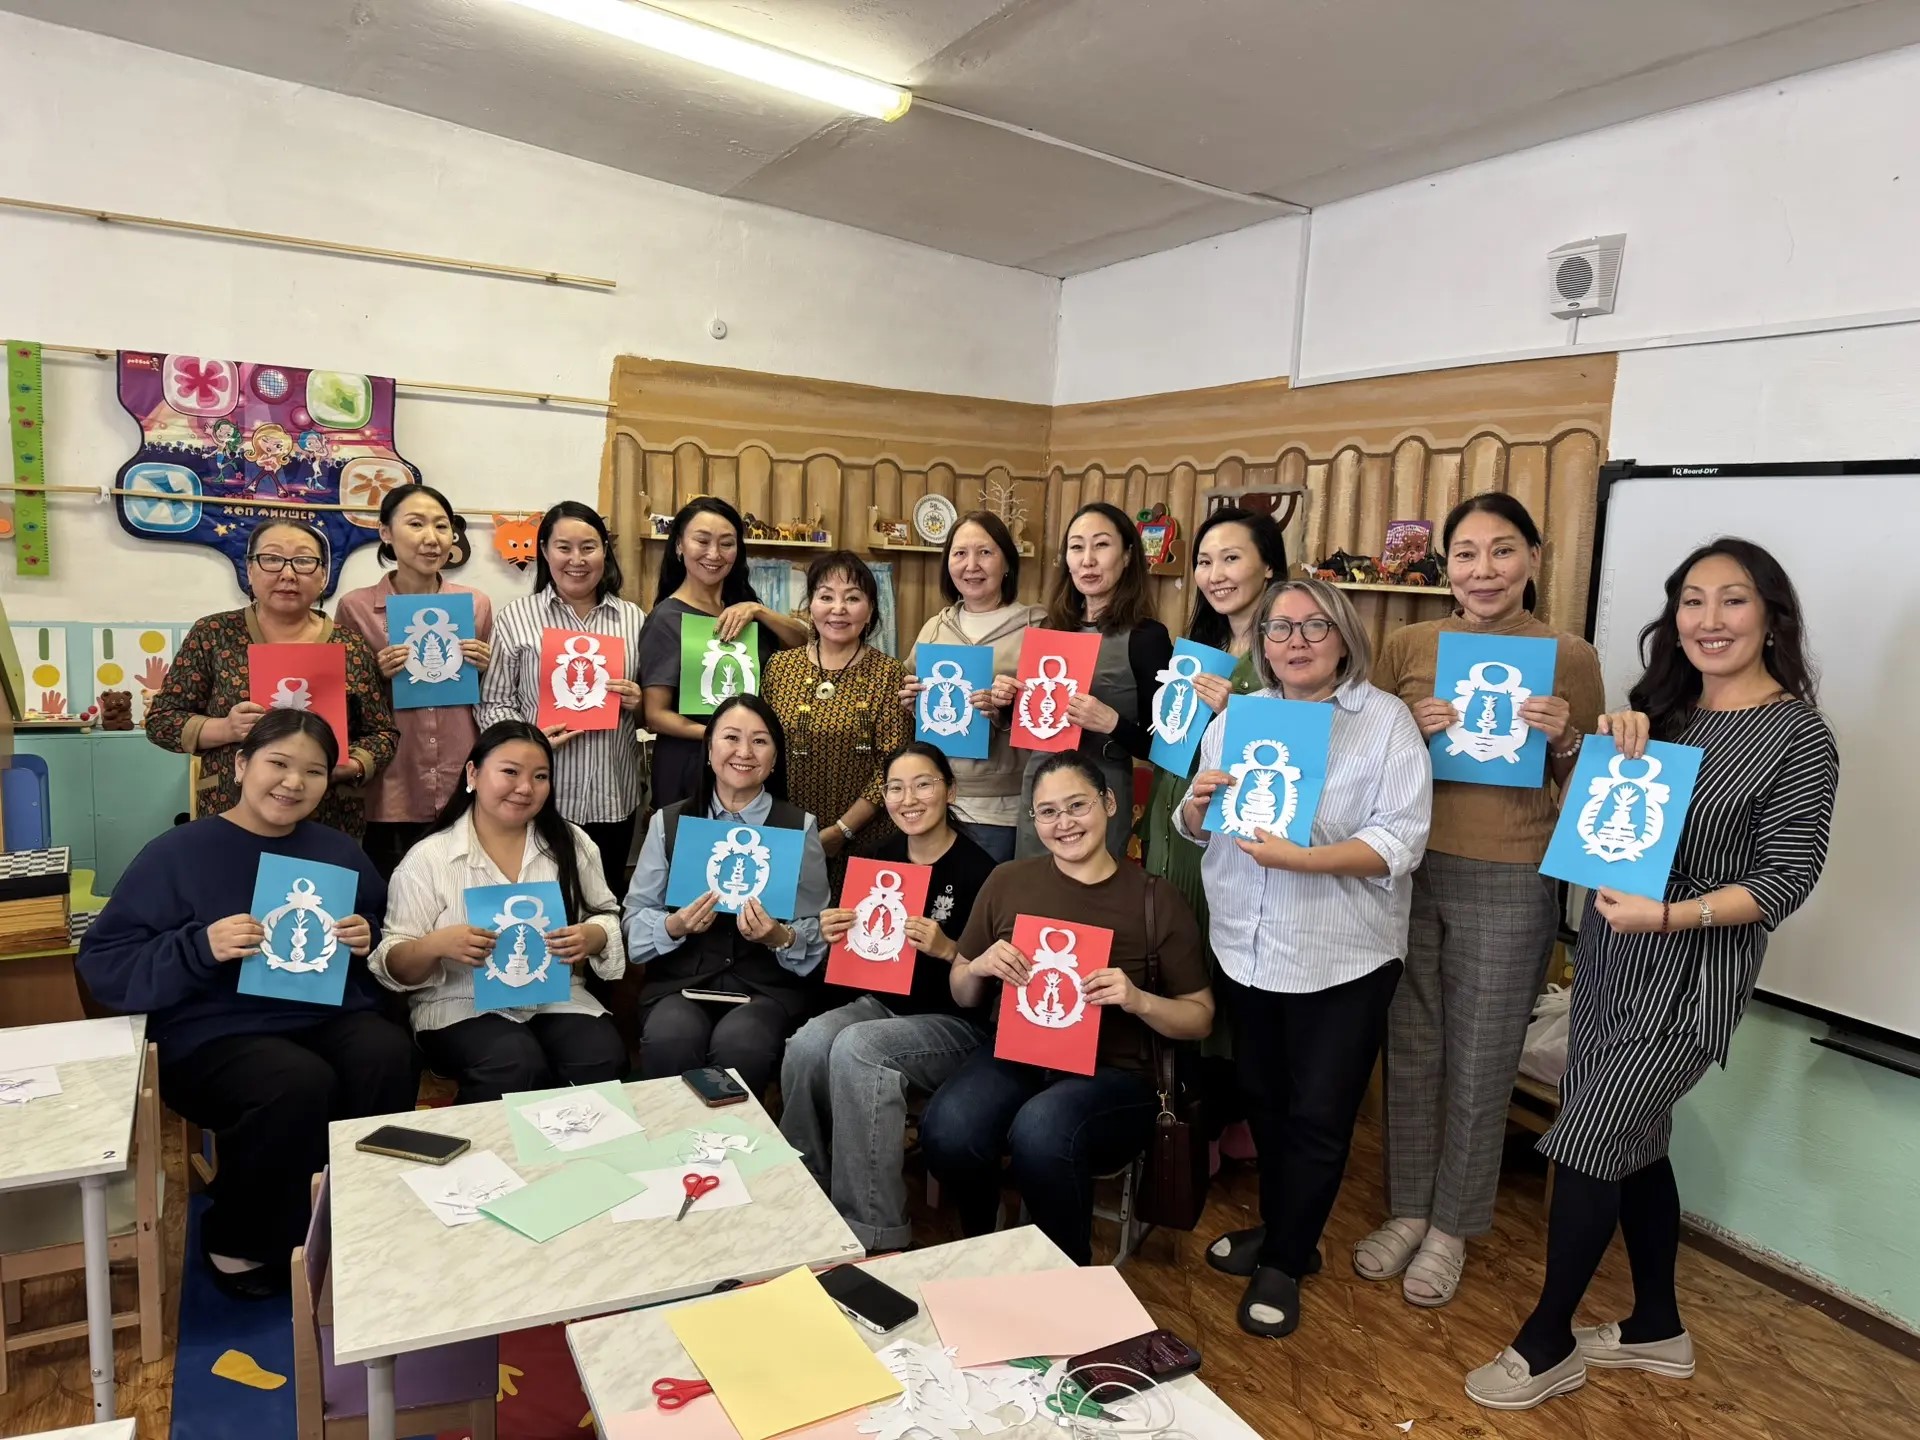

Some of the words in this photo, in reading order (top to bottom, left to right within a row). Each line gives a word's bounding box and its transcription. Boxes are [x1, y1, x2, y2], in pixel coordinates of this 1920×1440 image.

[223, 506, 254, 516] ХОП
[103, 1150, 116, 1159] 2
[841, 1243, 858, 1251] 2
